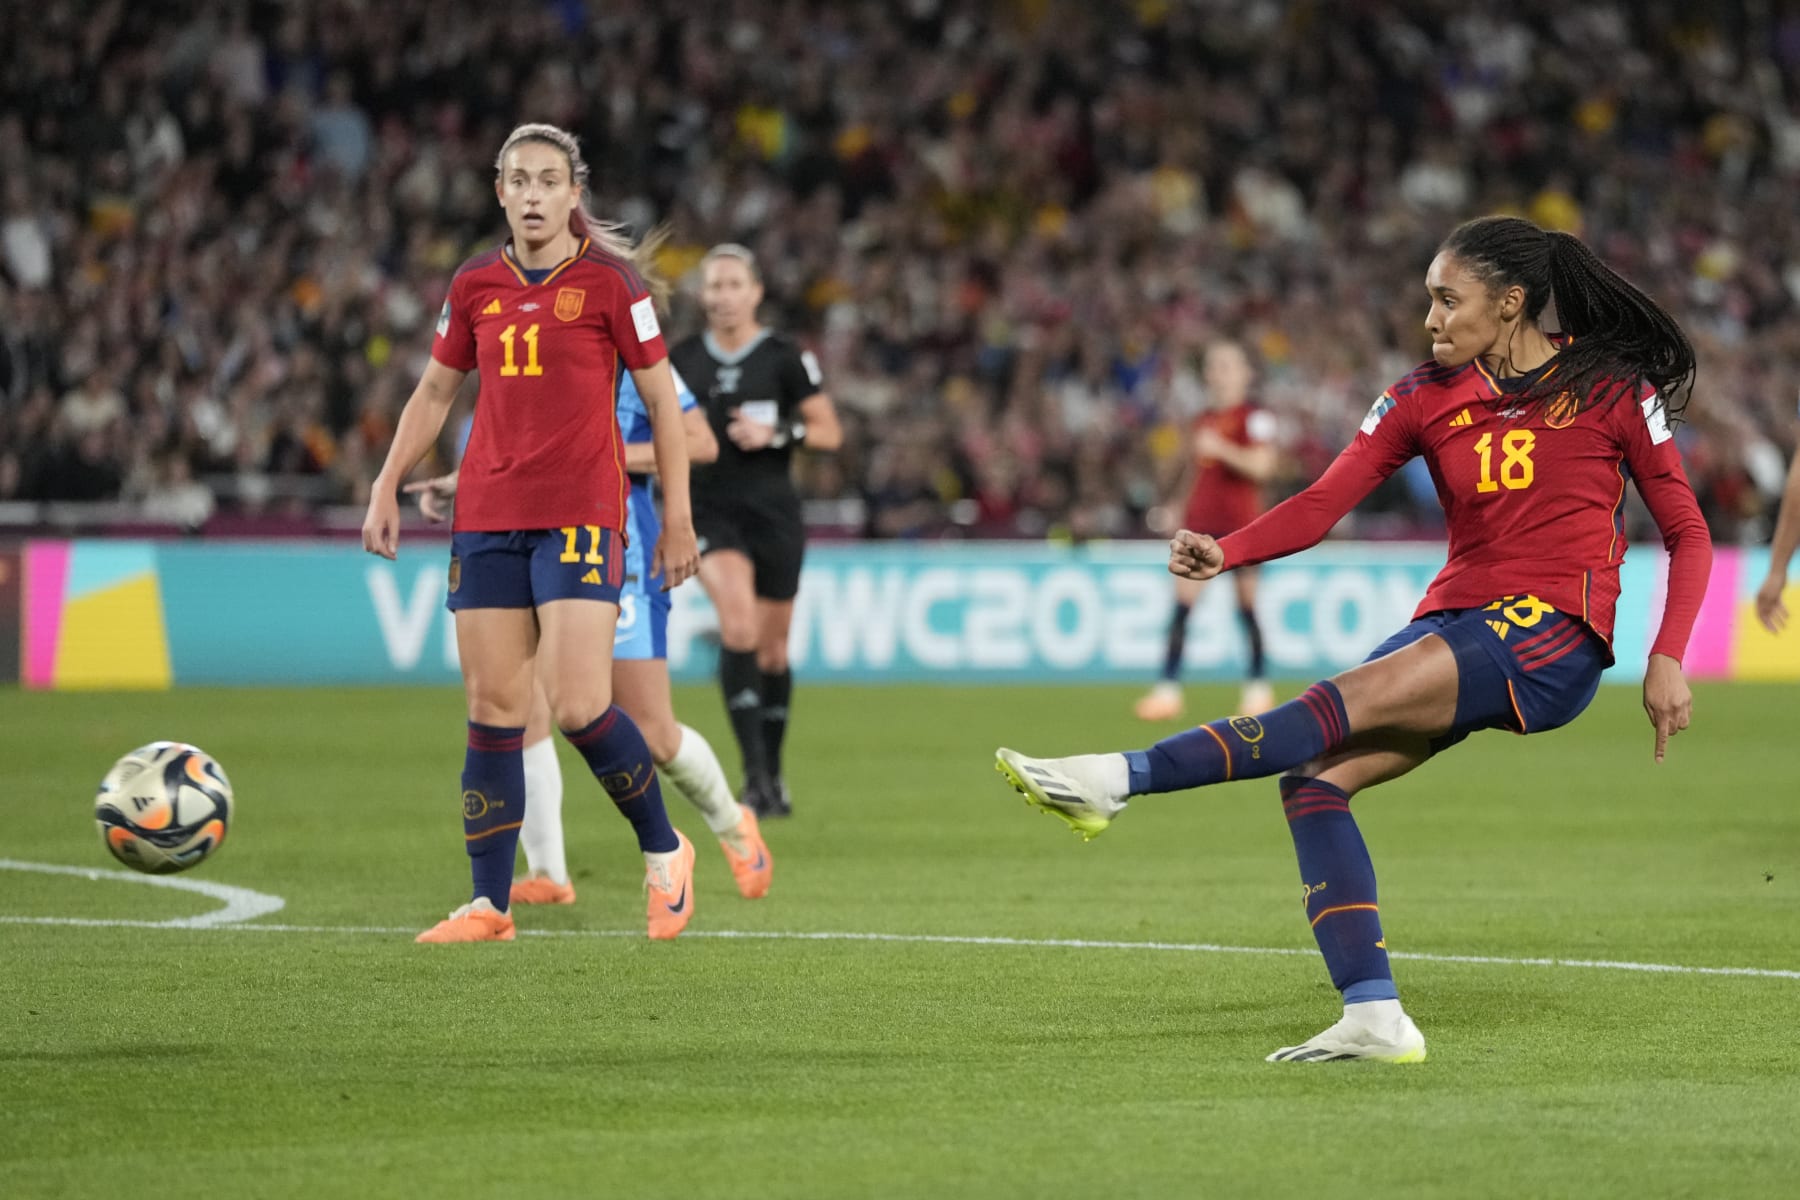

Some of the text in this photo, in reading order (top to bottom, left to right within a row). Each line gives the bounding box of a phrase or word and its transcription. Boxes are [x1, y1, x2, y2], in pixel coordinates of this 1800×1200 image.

[499, 324, 543, 376] 11
[1473, 429, 1536, 493] 18
[560, 525, 603, 564] 11
